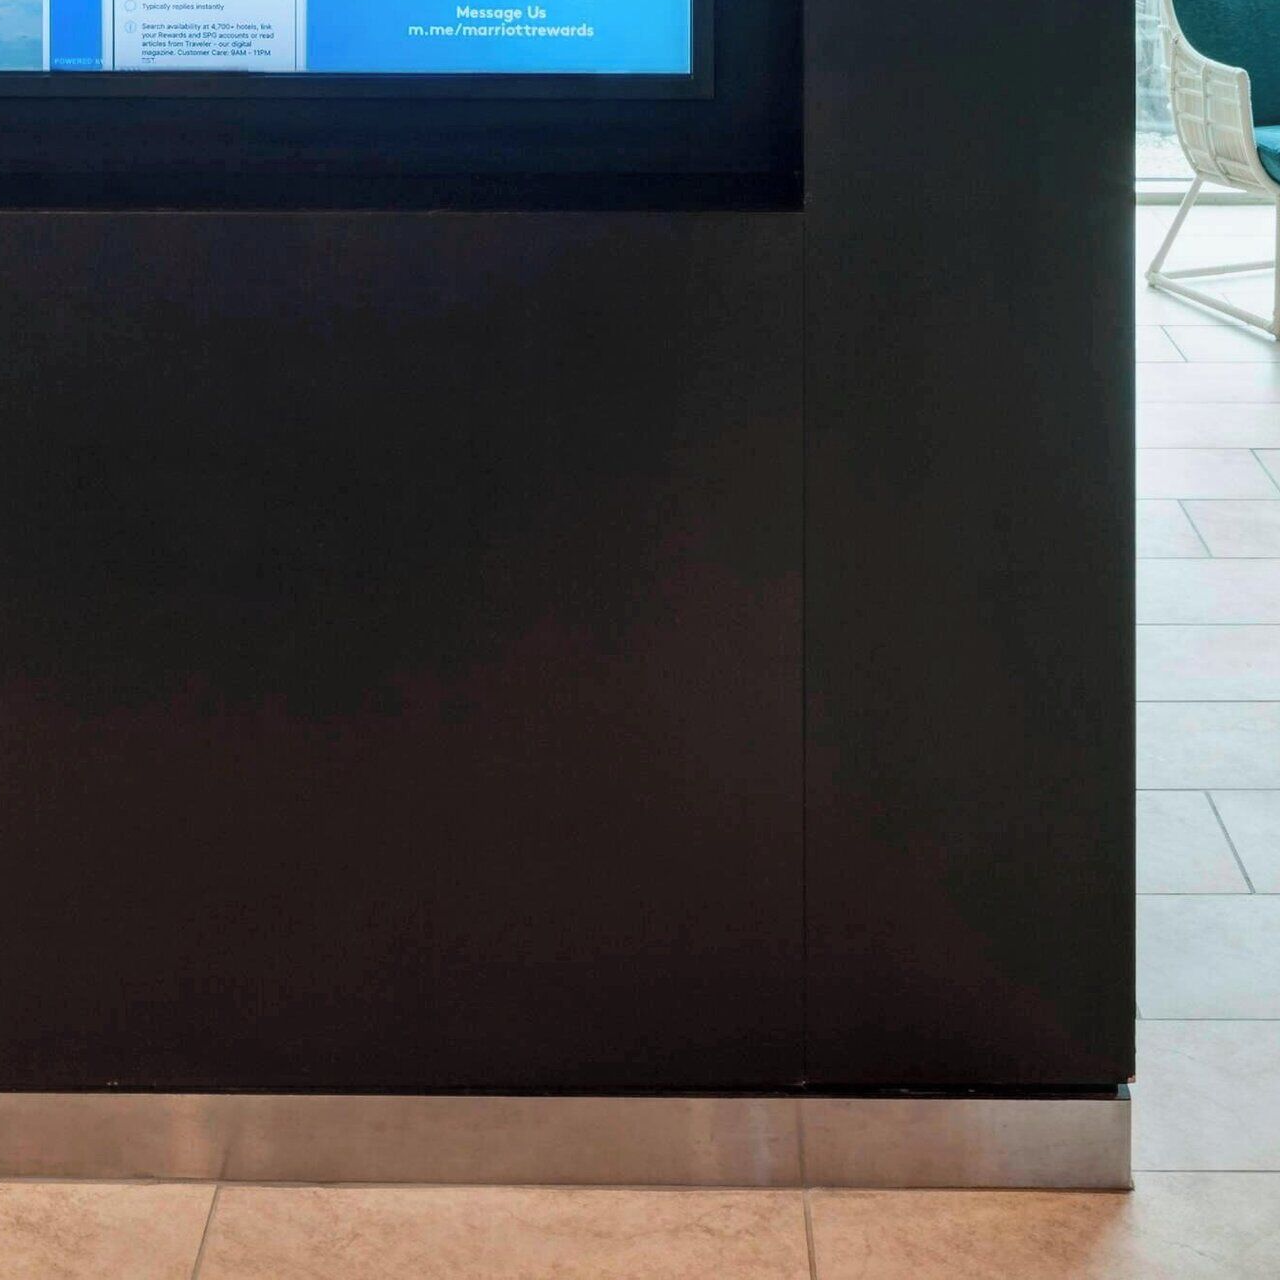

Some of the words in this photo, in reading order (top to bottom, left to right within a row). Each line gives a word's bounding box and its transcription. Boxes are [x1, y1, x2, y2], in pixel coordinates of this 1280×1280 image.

[457, 5, 523, 22] Message
[527, 5, 547, 19] Us
[408, 21, 595, 38] m.me/marriottrewards
